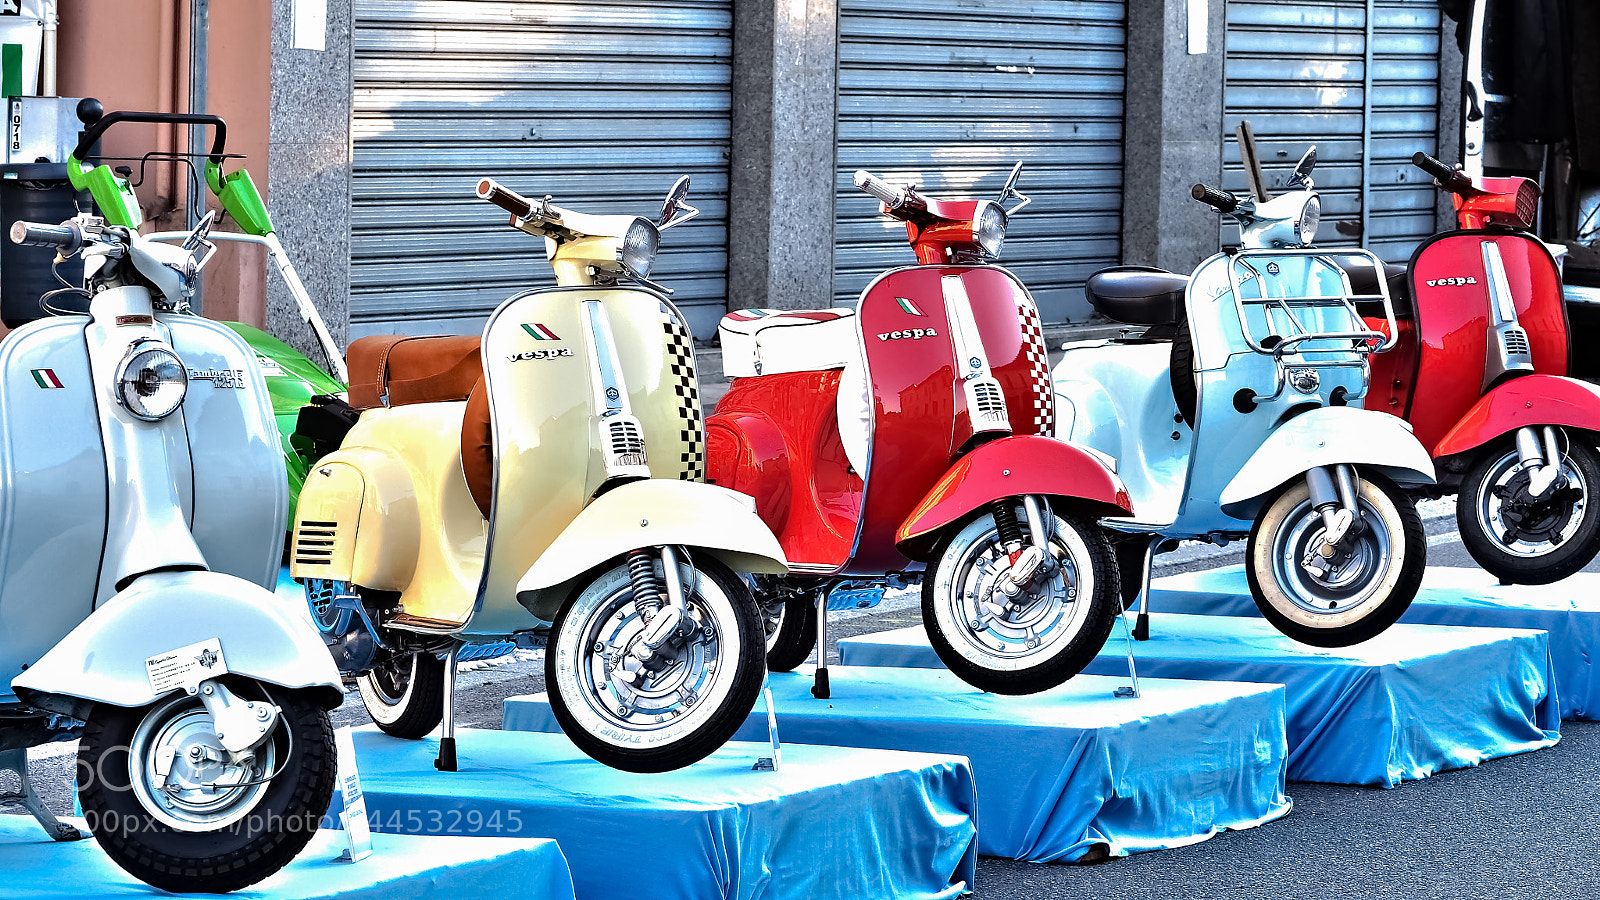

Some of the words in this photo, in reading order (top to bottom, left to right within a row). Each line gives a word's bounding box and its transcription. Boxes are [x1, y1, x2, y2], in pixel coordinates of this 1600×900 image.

[13, 115, 21, 150] 0718
[1426, 276, 1478, 287] vespa
[876, 328, 938, 341] vespa
[506, 347, 574, 362] vespa
